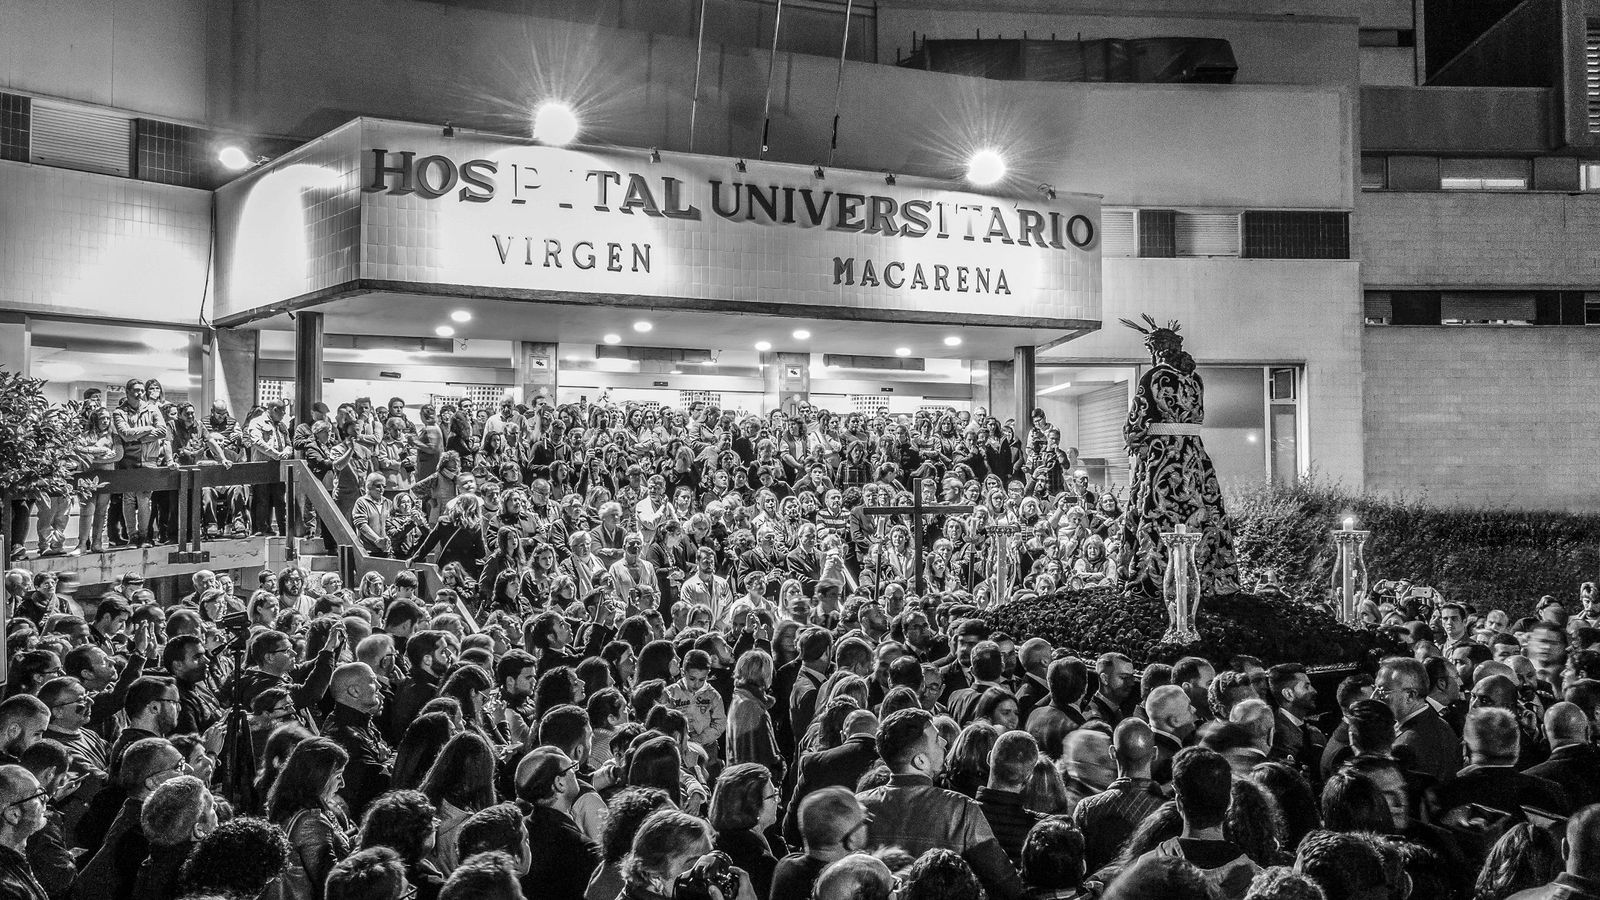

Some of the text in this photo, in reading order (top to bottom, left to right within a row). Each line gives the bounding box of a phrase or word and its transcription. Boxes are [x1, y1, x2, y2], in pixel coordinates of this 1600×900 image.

[371, 148, 1098, 251] HOSPTAL UNIVERSITARIO
[492, 234, 1011, 295] VIRGEN MACARENA
